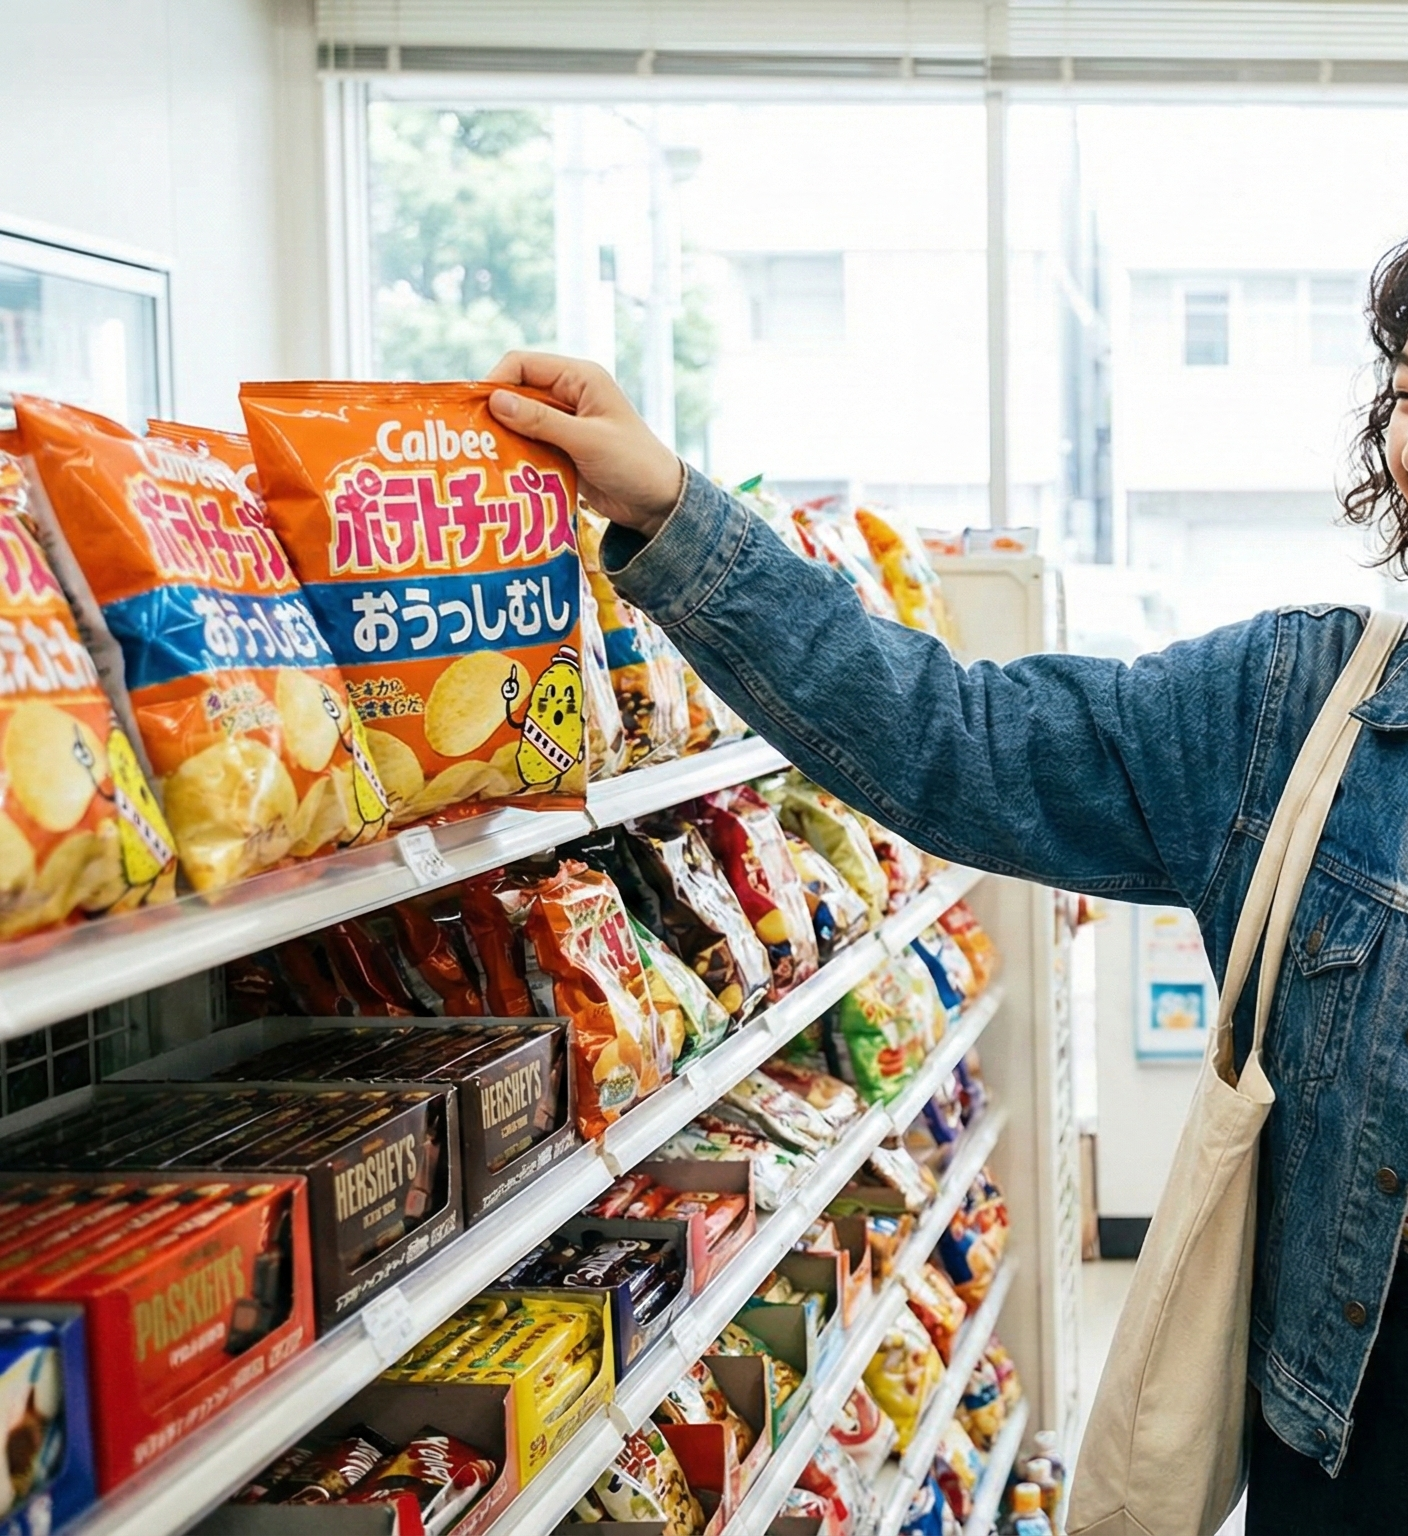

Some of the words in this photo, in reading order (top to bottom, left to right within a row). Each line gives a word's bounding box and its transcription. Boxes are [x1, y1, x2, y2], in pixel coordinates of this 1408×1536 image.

[375, 418, 499, 464] Calbee
[125, 474, 302, 588] ポテトチップ
[332, 462, 577, 572] ポテトチップス
[480, 1059, 543, 1131] HERSHEY'S
[333, 1132, 418, 1223] HERSHEY'S
